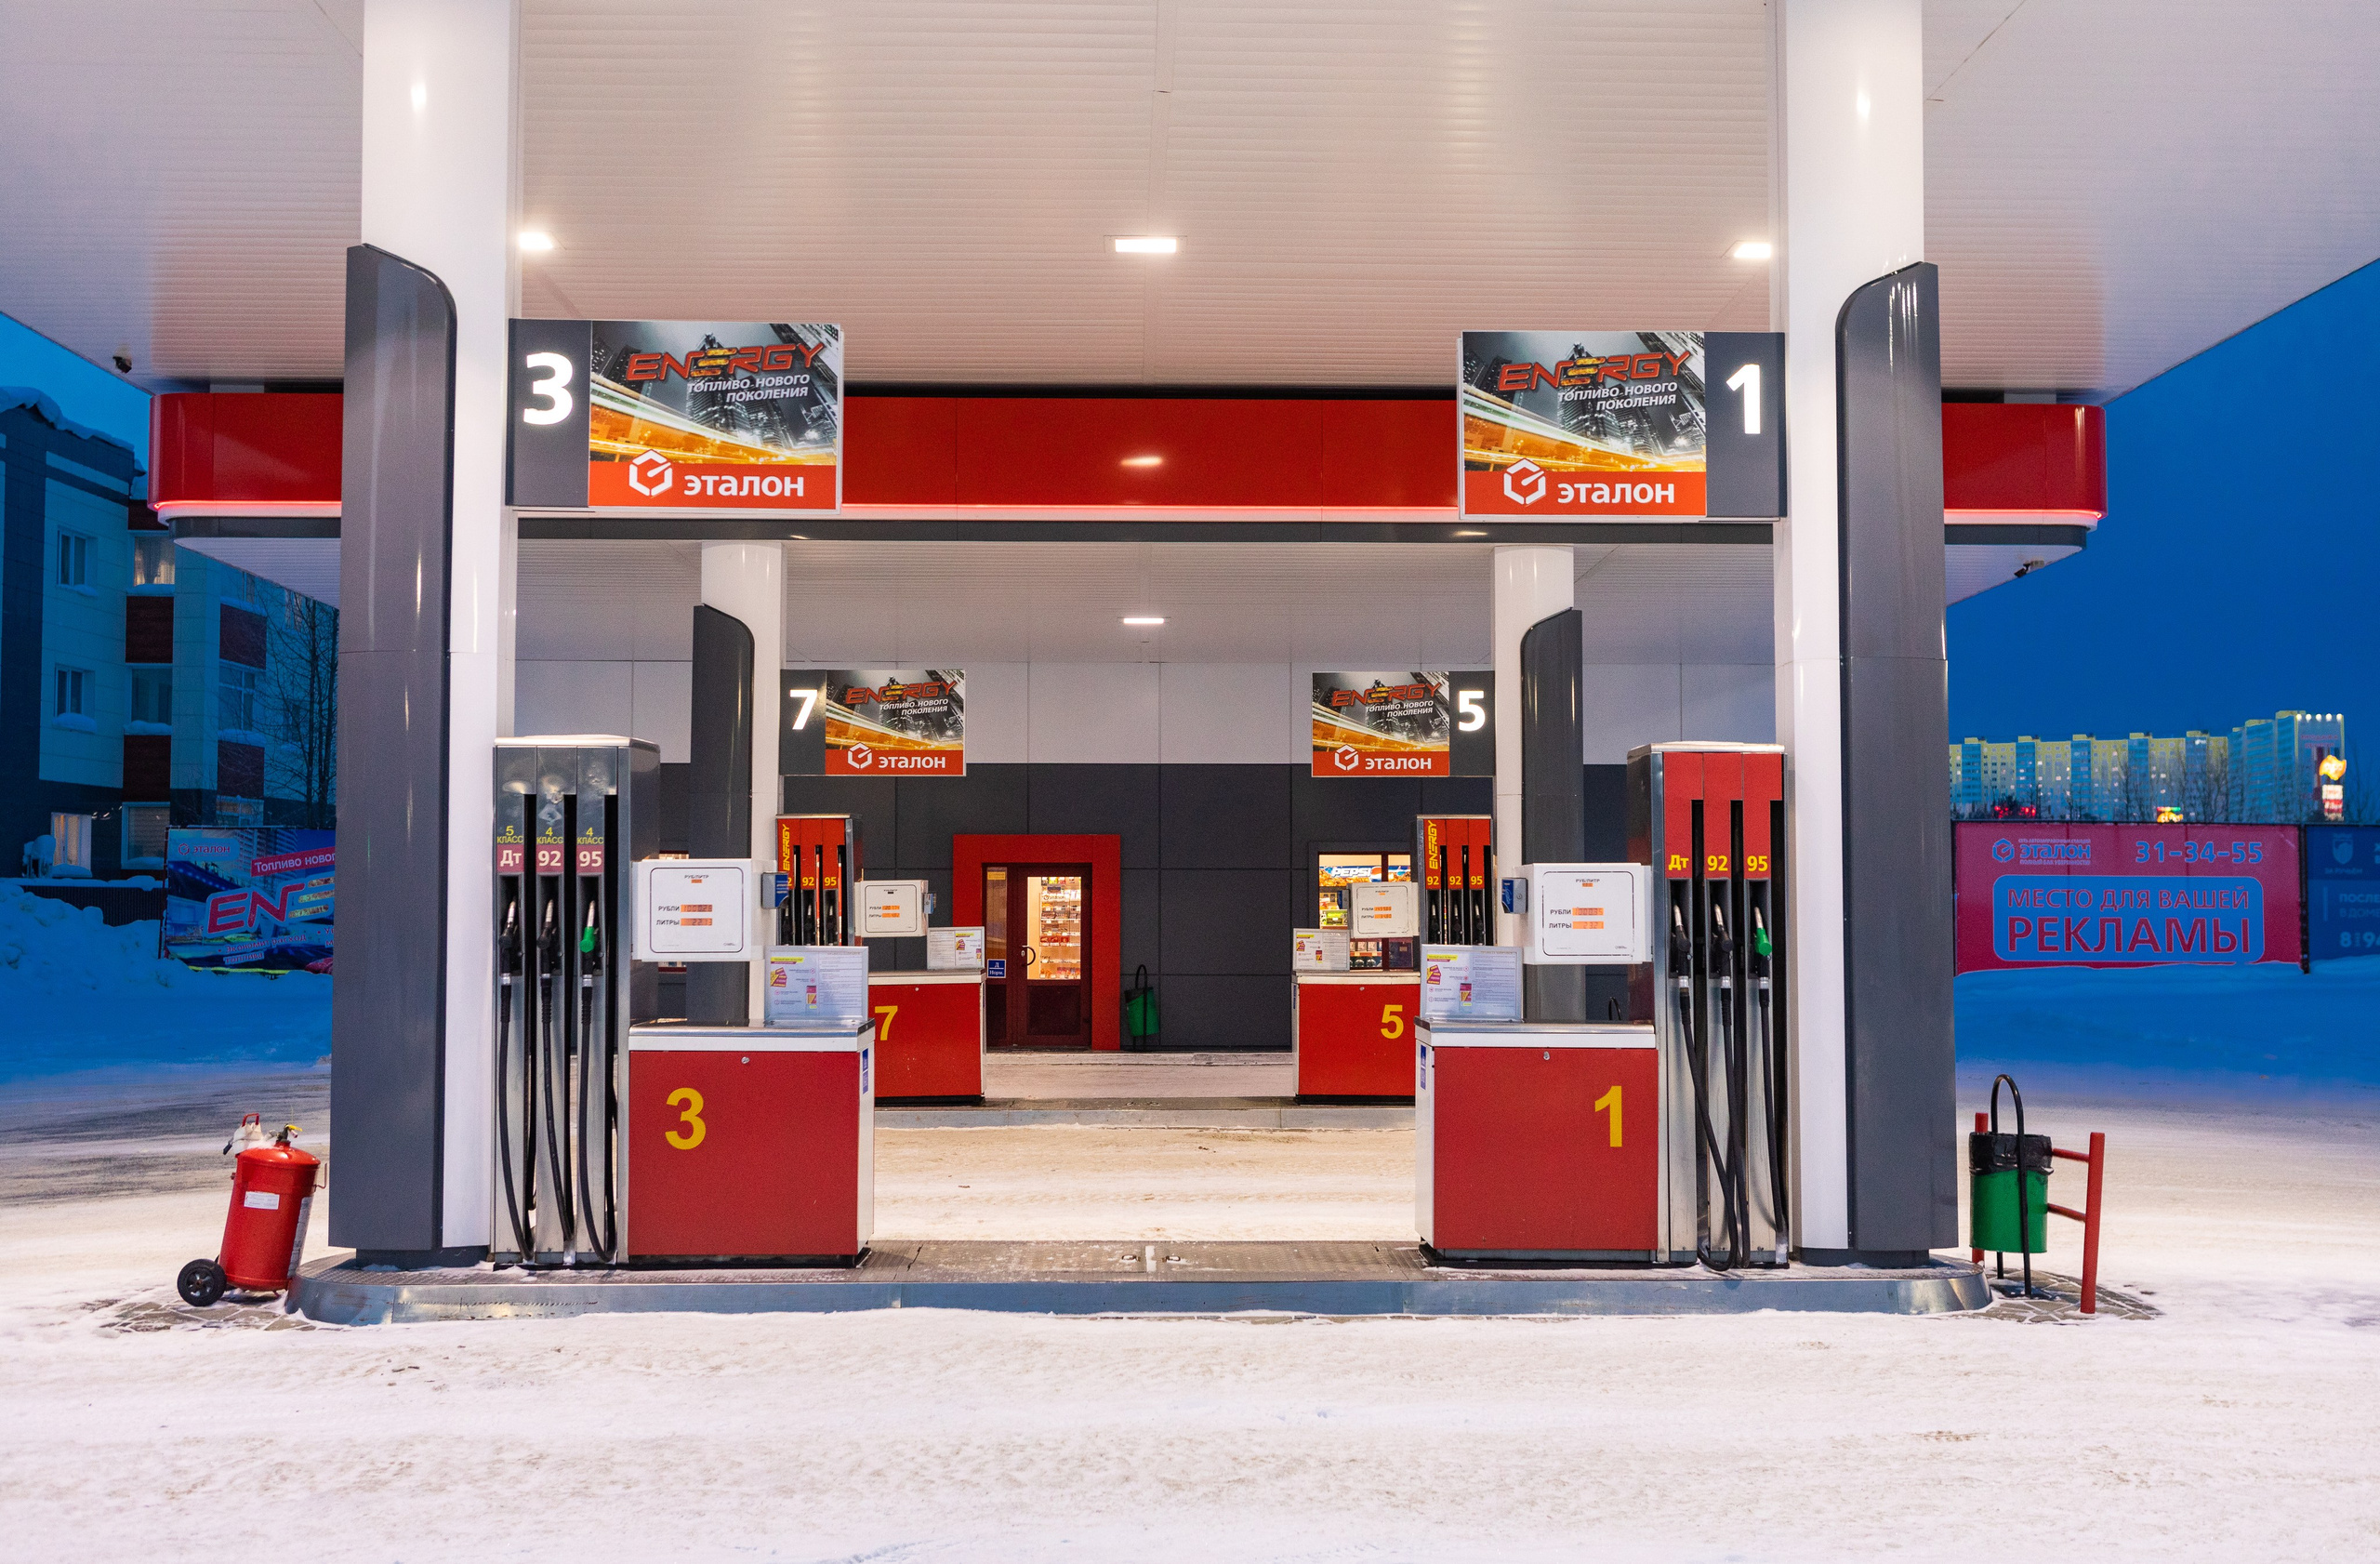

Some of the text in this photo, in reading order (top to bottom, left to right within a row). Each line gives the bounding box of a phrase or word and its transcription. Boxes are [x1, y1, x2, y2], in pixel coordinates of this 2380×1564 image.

[626, 342, 826, 380] ENERGY
[1498, 351, 1692, 391] ENERGY
[523, 351, 574, 425] 3
[688, 374, 811, 393] ТОПЛИВО НОВОГО
[1558, 381, 1678, 402] ТОПЛИВО НОВОГО
[726, 386, 809, 403] ПОКОЛЕНИЯ
[1596, 394, 1677, 411] ПОКОЛЕНИЯ
[1726, 364, 1761, 434] 1
[846, 681, 958, 705] ENERGY
[1331, 682, 1442, 707] ENERGY
[789, 689, 818, 731] 7
[879, 698, 949, 711] ТОПЛИВО НОВОГО
[901, 706, 948, 716] ПОКОЛЕНИЯ
[1366, 700, 1435, 713] ТОПЛИВО НОВОГО
[1387, 708, 1434, 718] ПОКОЛЕНИЯ
[1458, 690, 1486, 732] 5
[506, 826, 514, 836] 5
[545, 827, 553, 836] 4
[586, 827, 594, 836] 4
[1428, 820, 1438, 870] ENERGY
[2135, 841, 2263, 864] 31-34-55
[255, 858, 302, 872] Топливо
[500, 850, 522, 867] Дт
[537, 851, 562, 867] 92
[579, 851, 602, 867] 95
[1668, 855, 1689, 870] Дт
[1707, 855, 1728, 871] 92
[1747, 855, 1768, 871] 95
[801, 877, 815, 886] 92
[824, 877, 837, 886] 95
[1331, 868, 1371, 878] PEPSI
[1427, 876, 1439, 885] 92
[1449, 876, 1461, 885] 92
[1471, 876, 1483, 885] 95
[2007, 884, 2250, 911] МЕСТО ДЛЯ ВАШЕЙ
[271, 934, 307, 947] расход
[2008, 916, 2251, 954] РЕКЛАМЫ
[2340, 931, 2352, 948] 8
[874, 1005, 899, 1041] 7
[1380, 1004, 1405, 1040] 5
[665, 1087, 707, 1150] 3
[1594, 1085, 1623, 1147] 1
